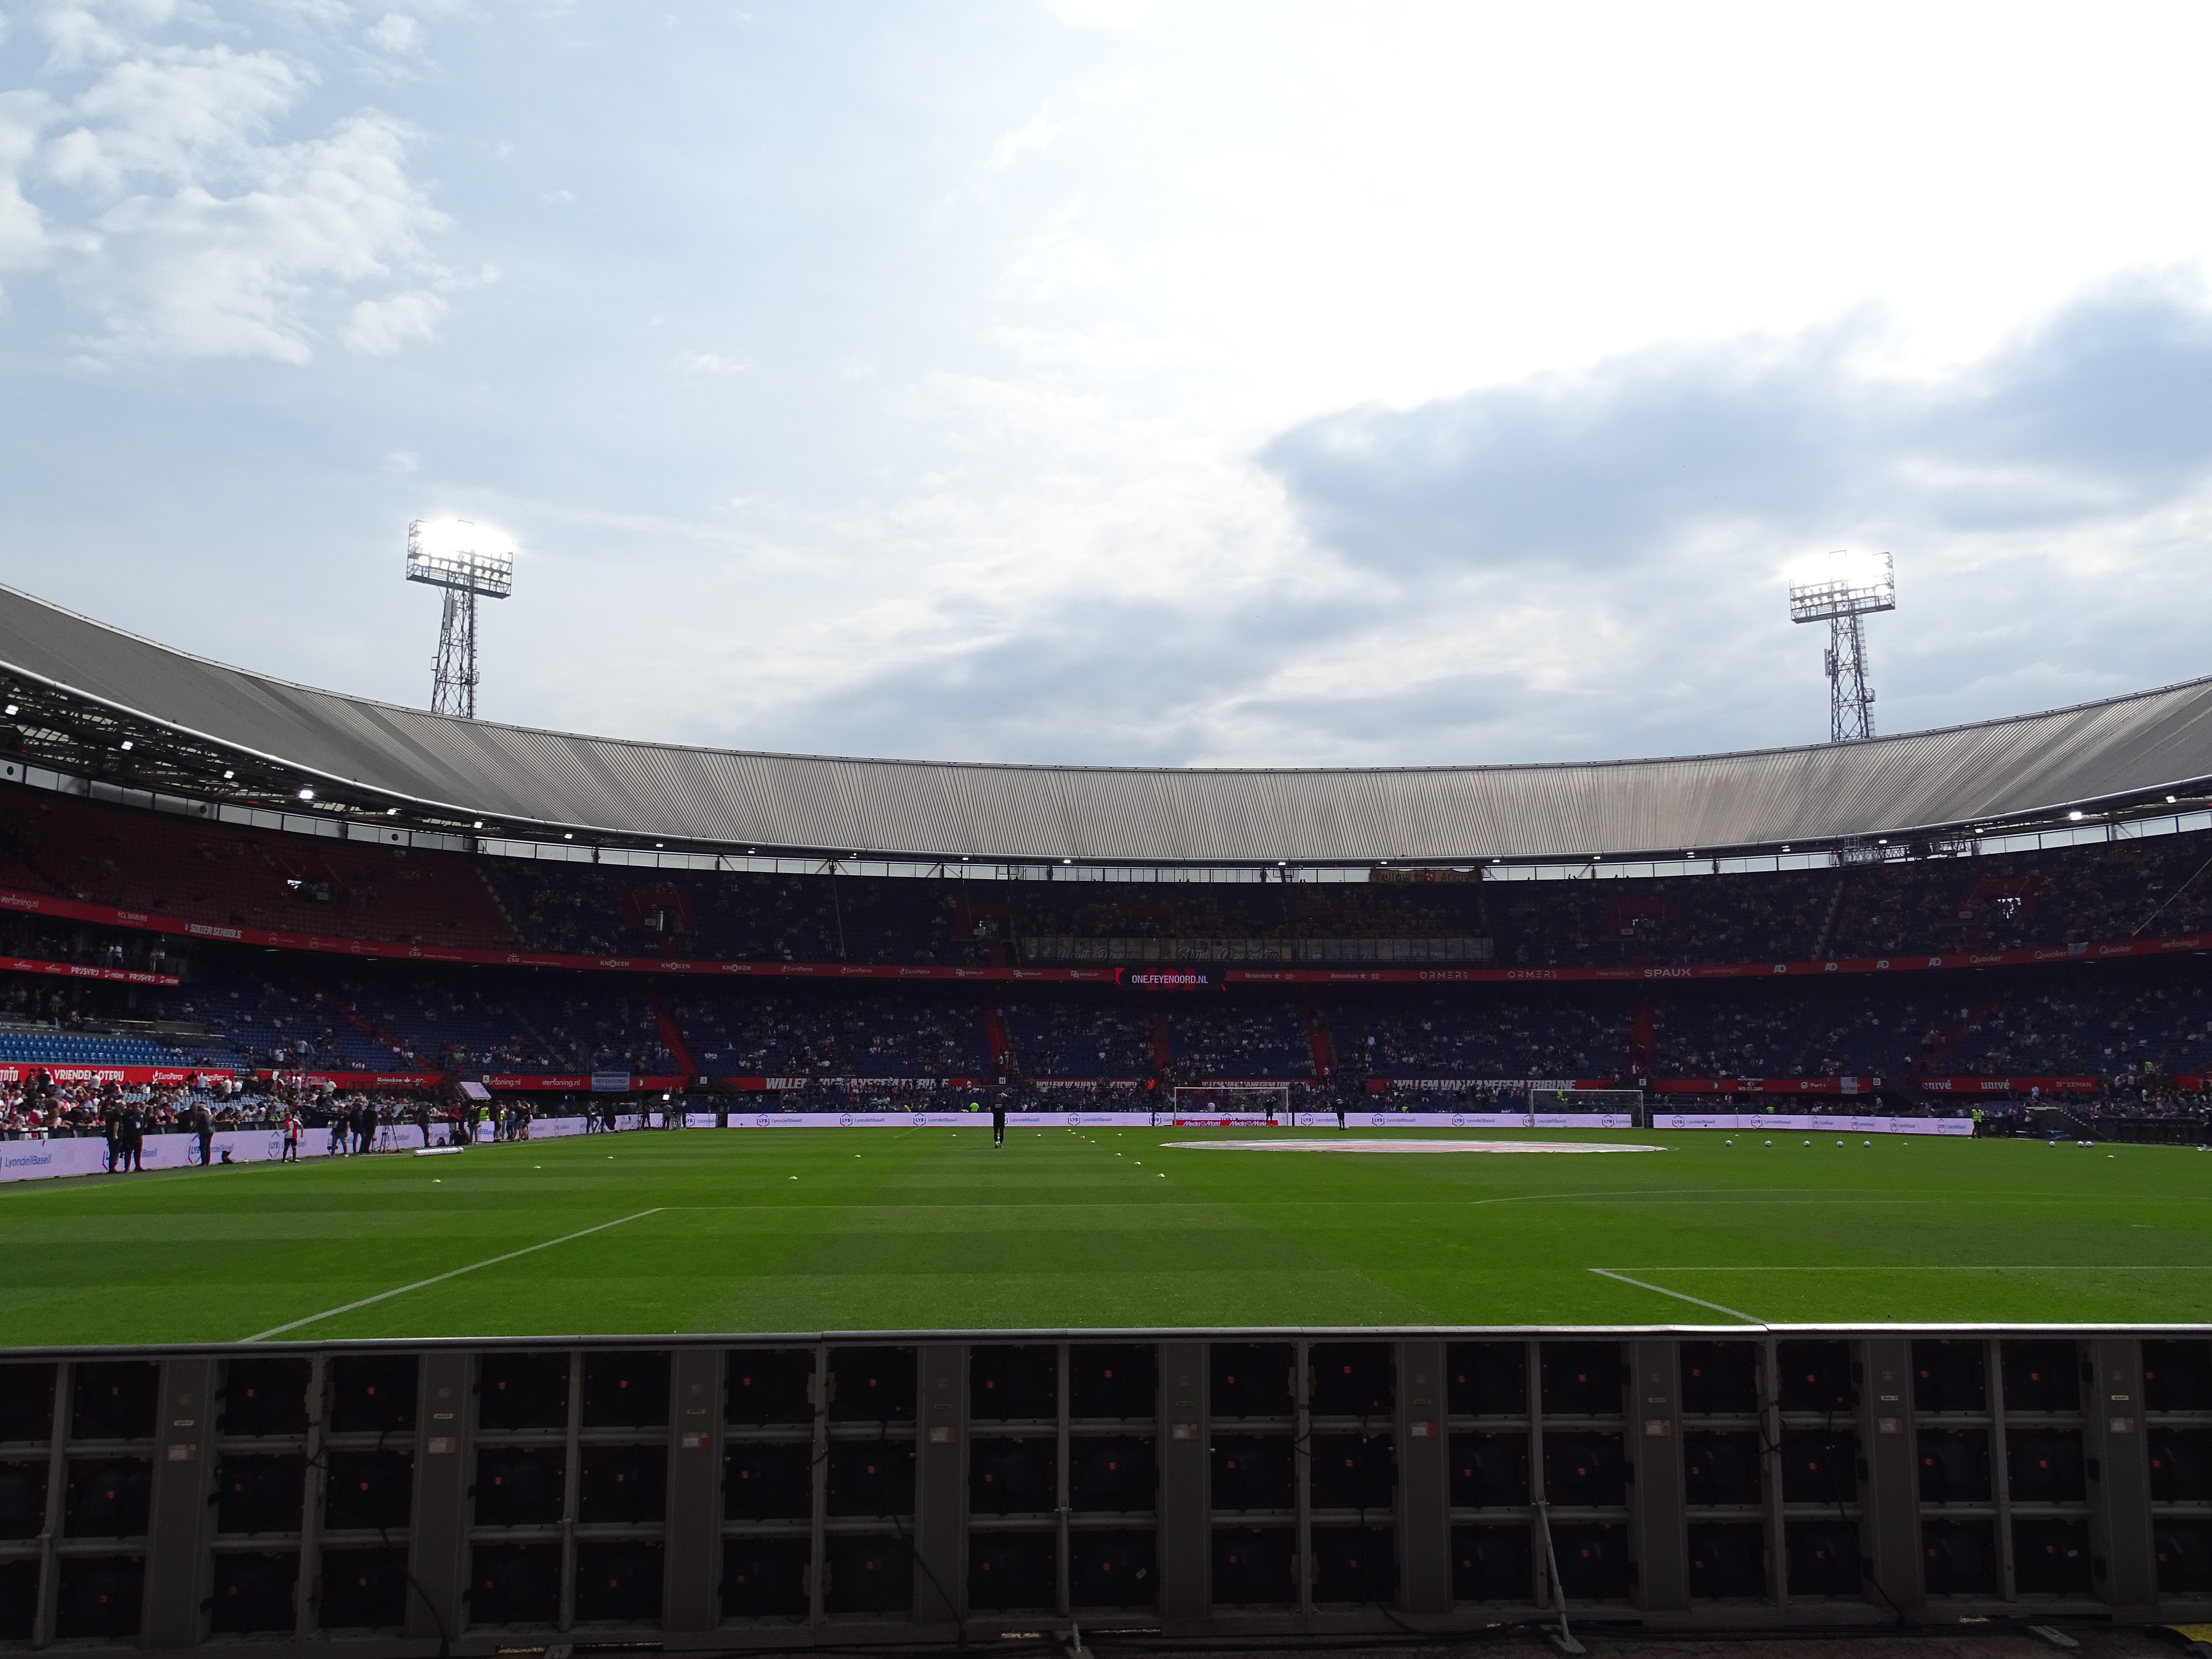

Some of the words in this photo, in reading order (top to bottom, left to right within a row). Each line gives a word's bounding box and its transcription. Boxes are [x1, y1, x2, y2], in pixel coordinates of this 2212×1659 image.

[1375, 870, 1411, 882] Yellow
[1441, 873, 1471, 882] Army
[1, 895, 39, 909] verloning.nl
[128, 913, 148, 922] MARINE
[190, 924, 212, 935] SOCCER
[213, 927, 242, 939] SCHOOLS
[2034, 950, 2067, 959] Quooker
[2099, 946, 2132, 955] Quooker
[1928, 958, 1941, 967] AD
[1970, 955, 2002, 963] Quooker
[1773, 964, 1787, 973] AD
[1825, 963, 1838, 971] AD
[1876, 960, 1889, 969] AD
[71, 966, 99, 976] PRIJSVRIJ
[1644, 968, 1691, 977] SPAUX
[129, 973, 155, 982] PRIJSVRIJ
[1132, 975, 1208, 984] ONE.FEYENOORD.NL
[158, 1072, 183, 1080] EuroParcs
[542, 1077, 580, 1087] verloning.nl
[1526, 1080, 1576, 1089] TRIBUNE
[1981, 1079, 2010, 1089] univé
[5, 1153, 52, 1167] LyondellBasell
